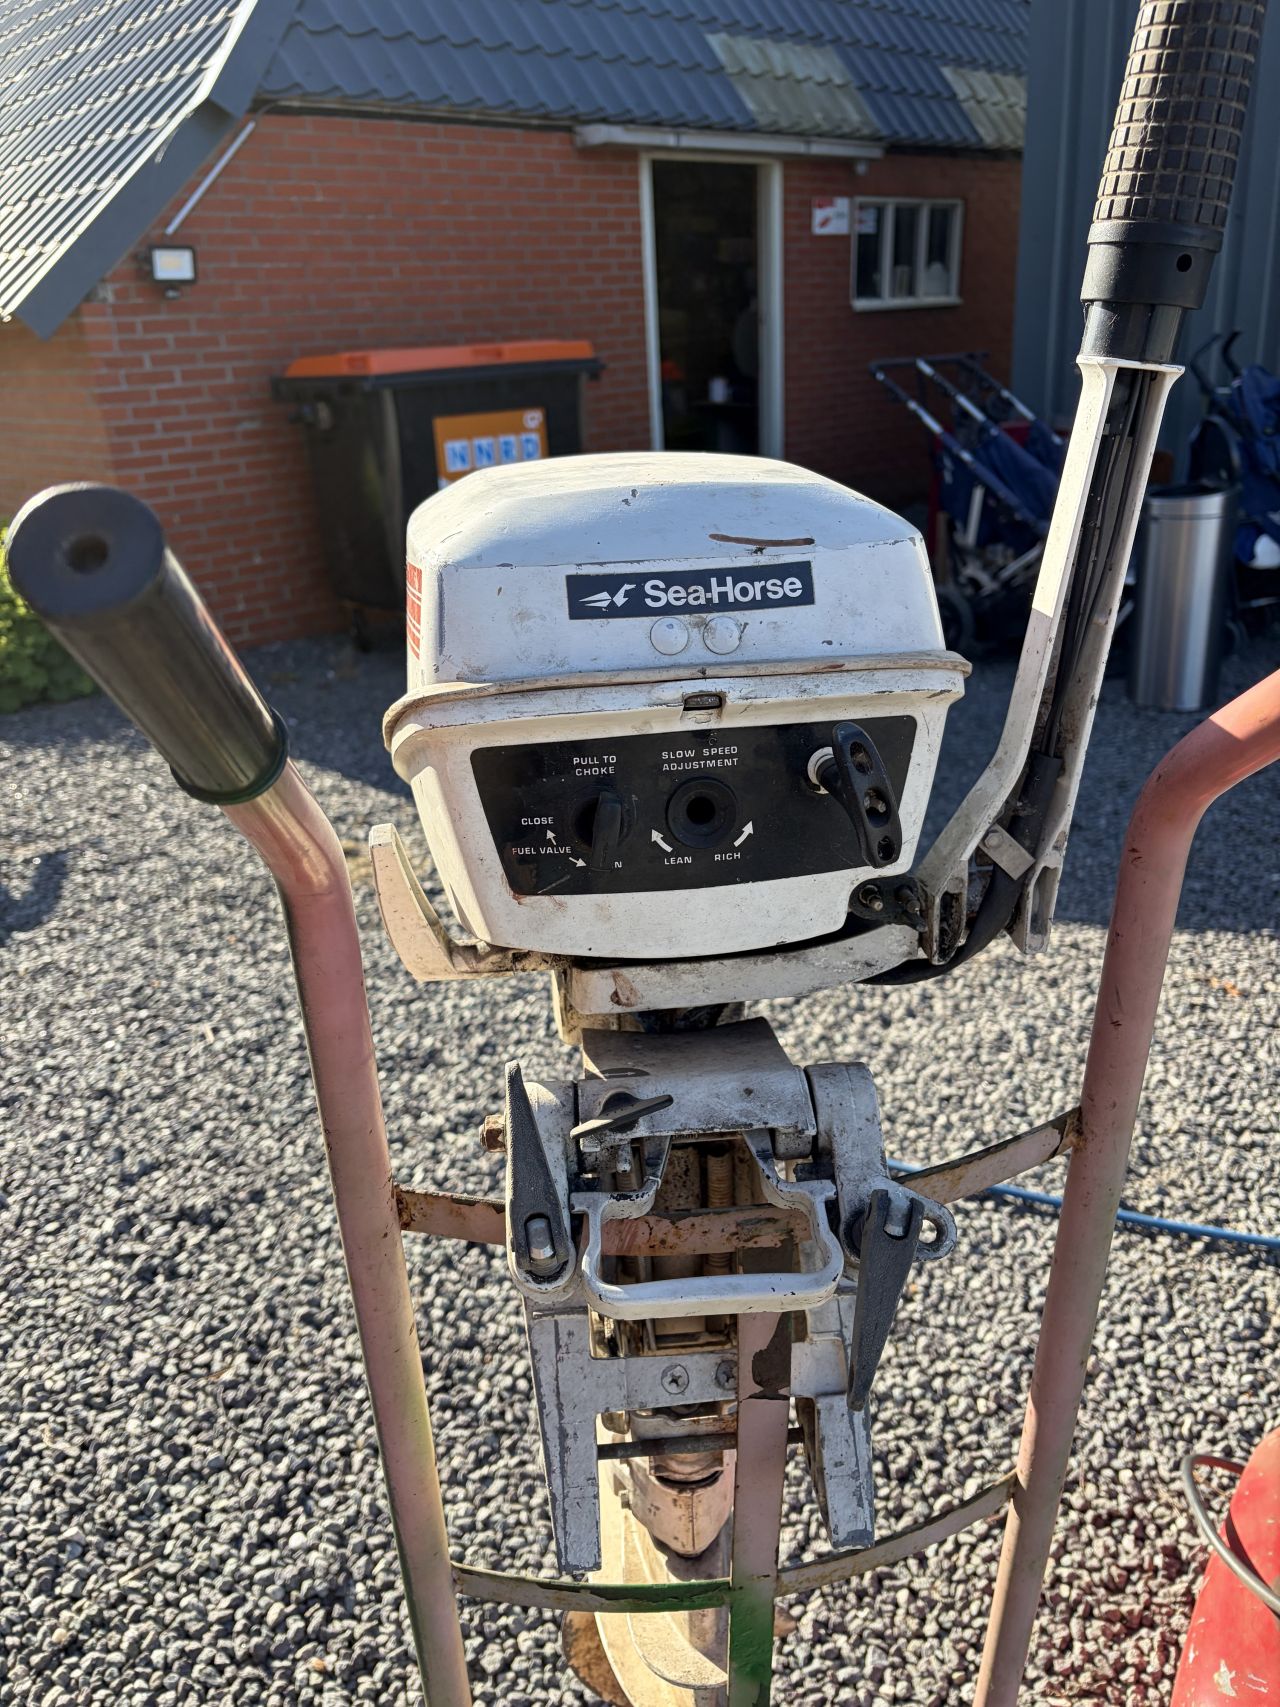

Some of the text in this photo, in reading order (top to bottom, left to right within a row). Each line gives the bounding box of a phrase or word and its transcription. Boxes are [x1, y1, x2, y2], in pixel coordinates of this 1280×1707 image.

[644, 576, 803, 608] Sea-Horse
[661, 746, 738, 759] SLOW SPEED
[573, 755, 617, 765] PULL TO
[662, 758, 739, 771] ADJUSTMENT
[575, 766, 616, 776] CHOKE
[521, 817, 555, 825] CLOSE
[512, 846, 572, 855] FUEL VALVE
[664, 856, 693, 865] LEAN
[714, 852, 741, 861] RICH
